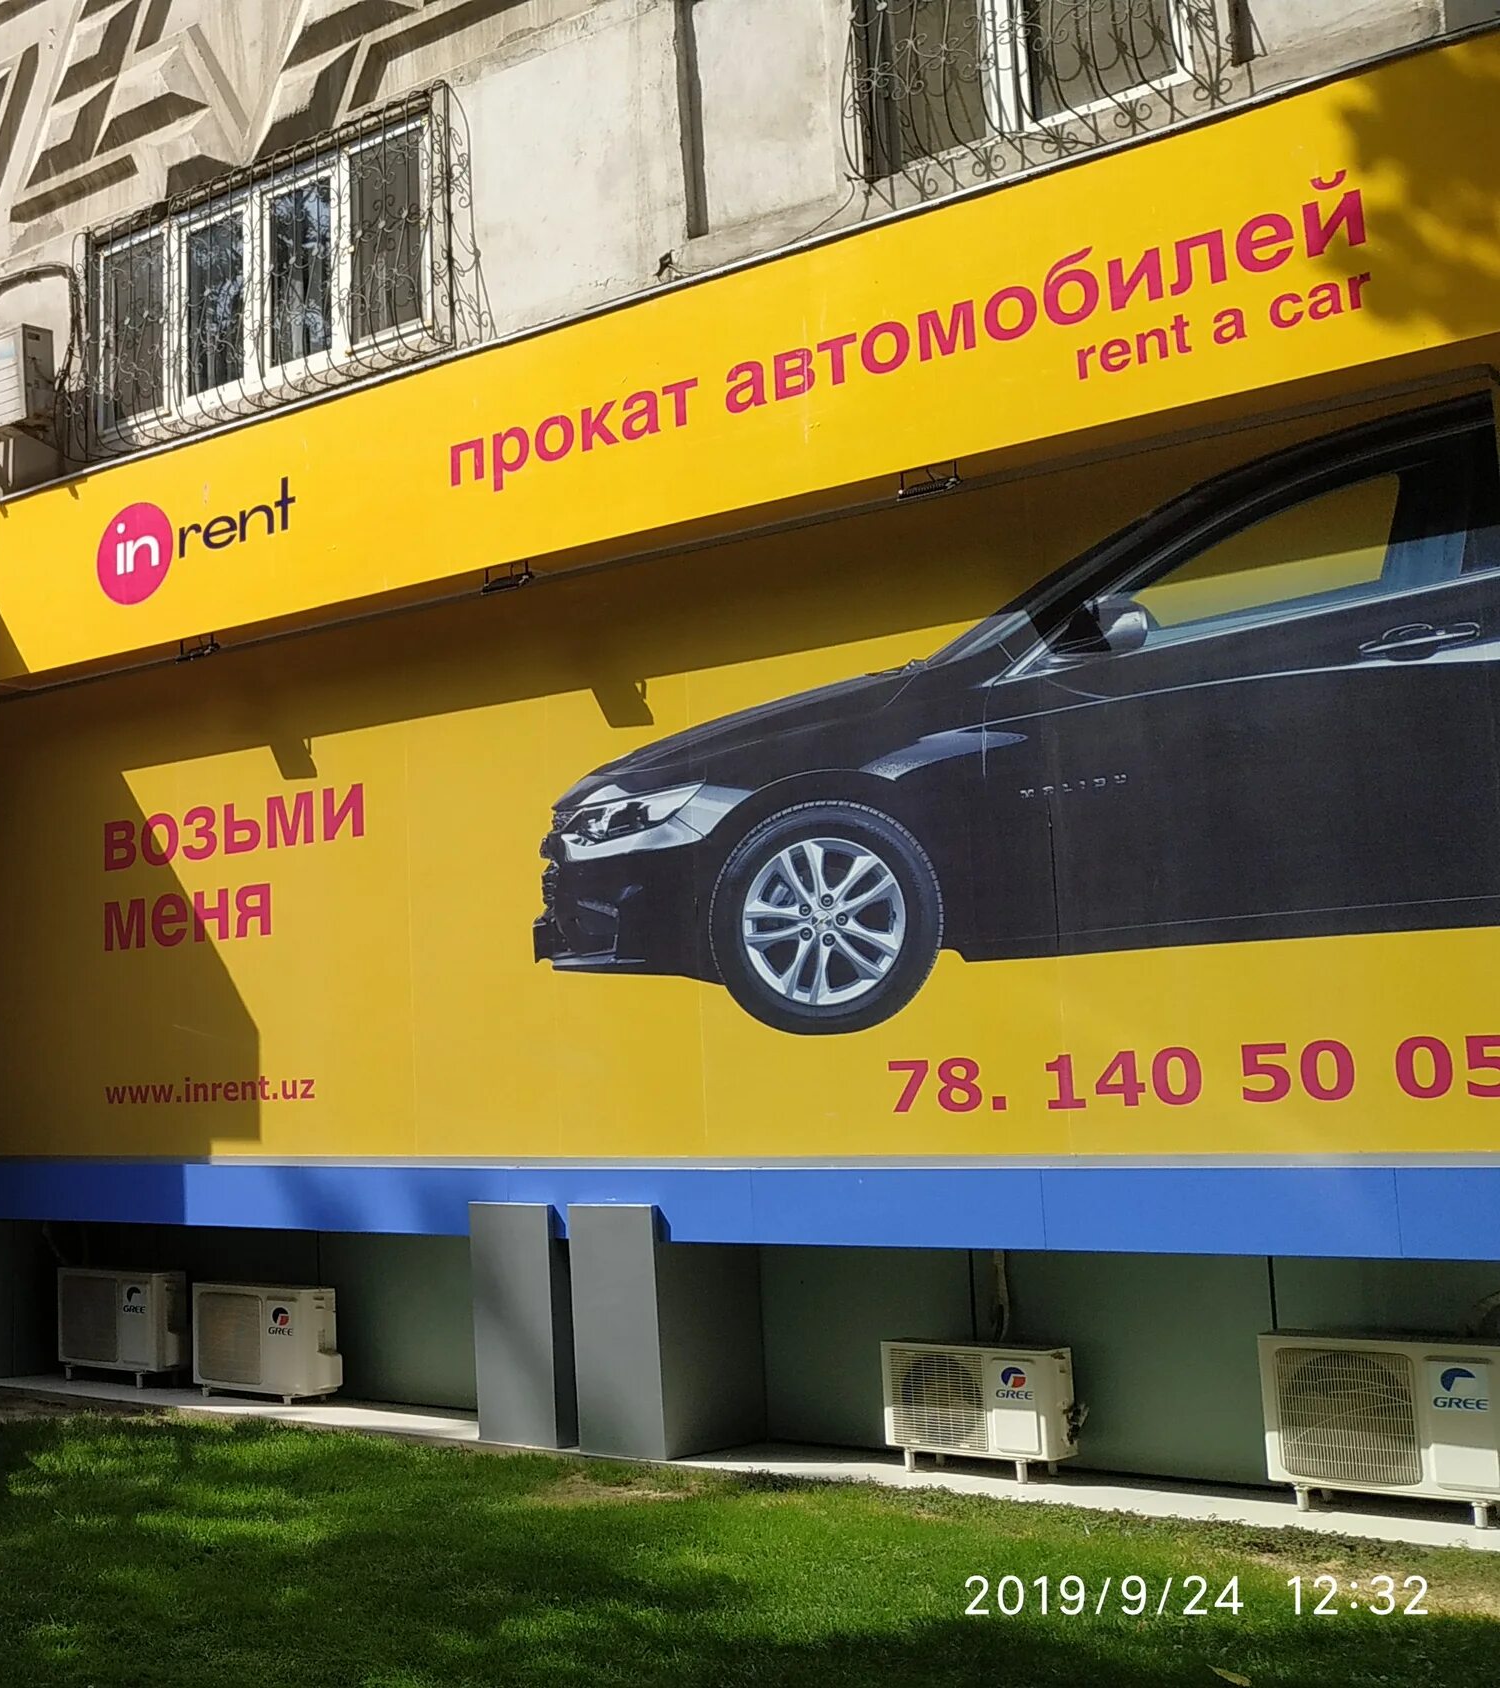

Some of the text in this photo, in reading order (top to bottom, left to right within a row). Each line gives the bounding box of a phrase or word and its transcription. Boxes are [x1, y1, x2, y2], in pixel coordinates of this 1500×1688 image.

[450, 171, 1368, 493] прокат автомобилей
[1076, 272, 1371, 380] rent a car
[115, 476, 297, 576] in rent
[103, 882, 272, 952] меня
[104, 1075, 316, 1104] www.inrent.uz
[887, 1035, 1500, 1114] 78. 140 50 05
[122, 1304, 147, 1314] GREE
[268, 1326, 293, 1337] GREE
[995, 1389, 1034, 1400] GREE
[1432, 1396, 1489, 1411] GREE
